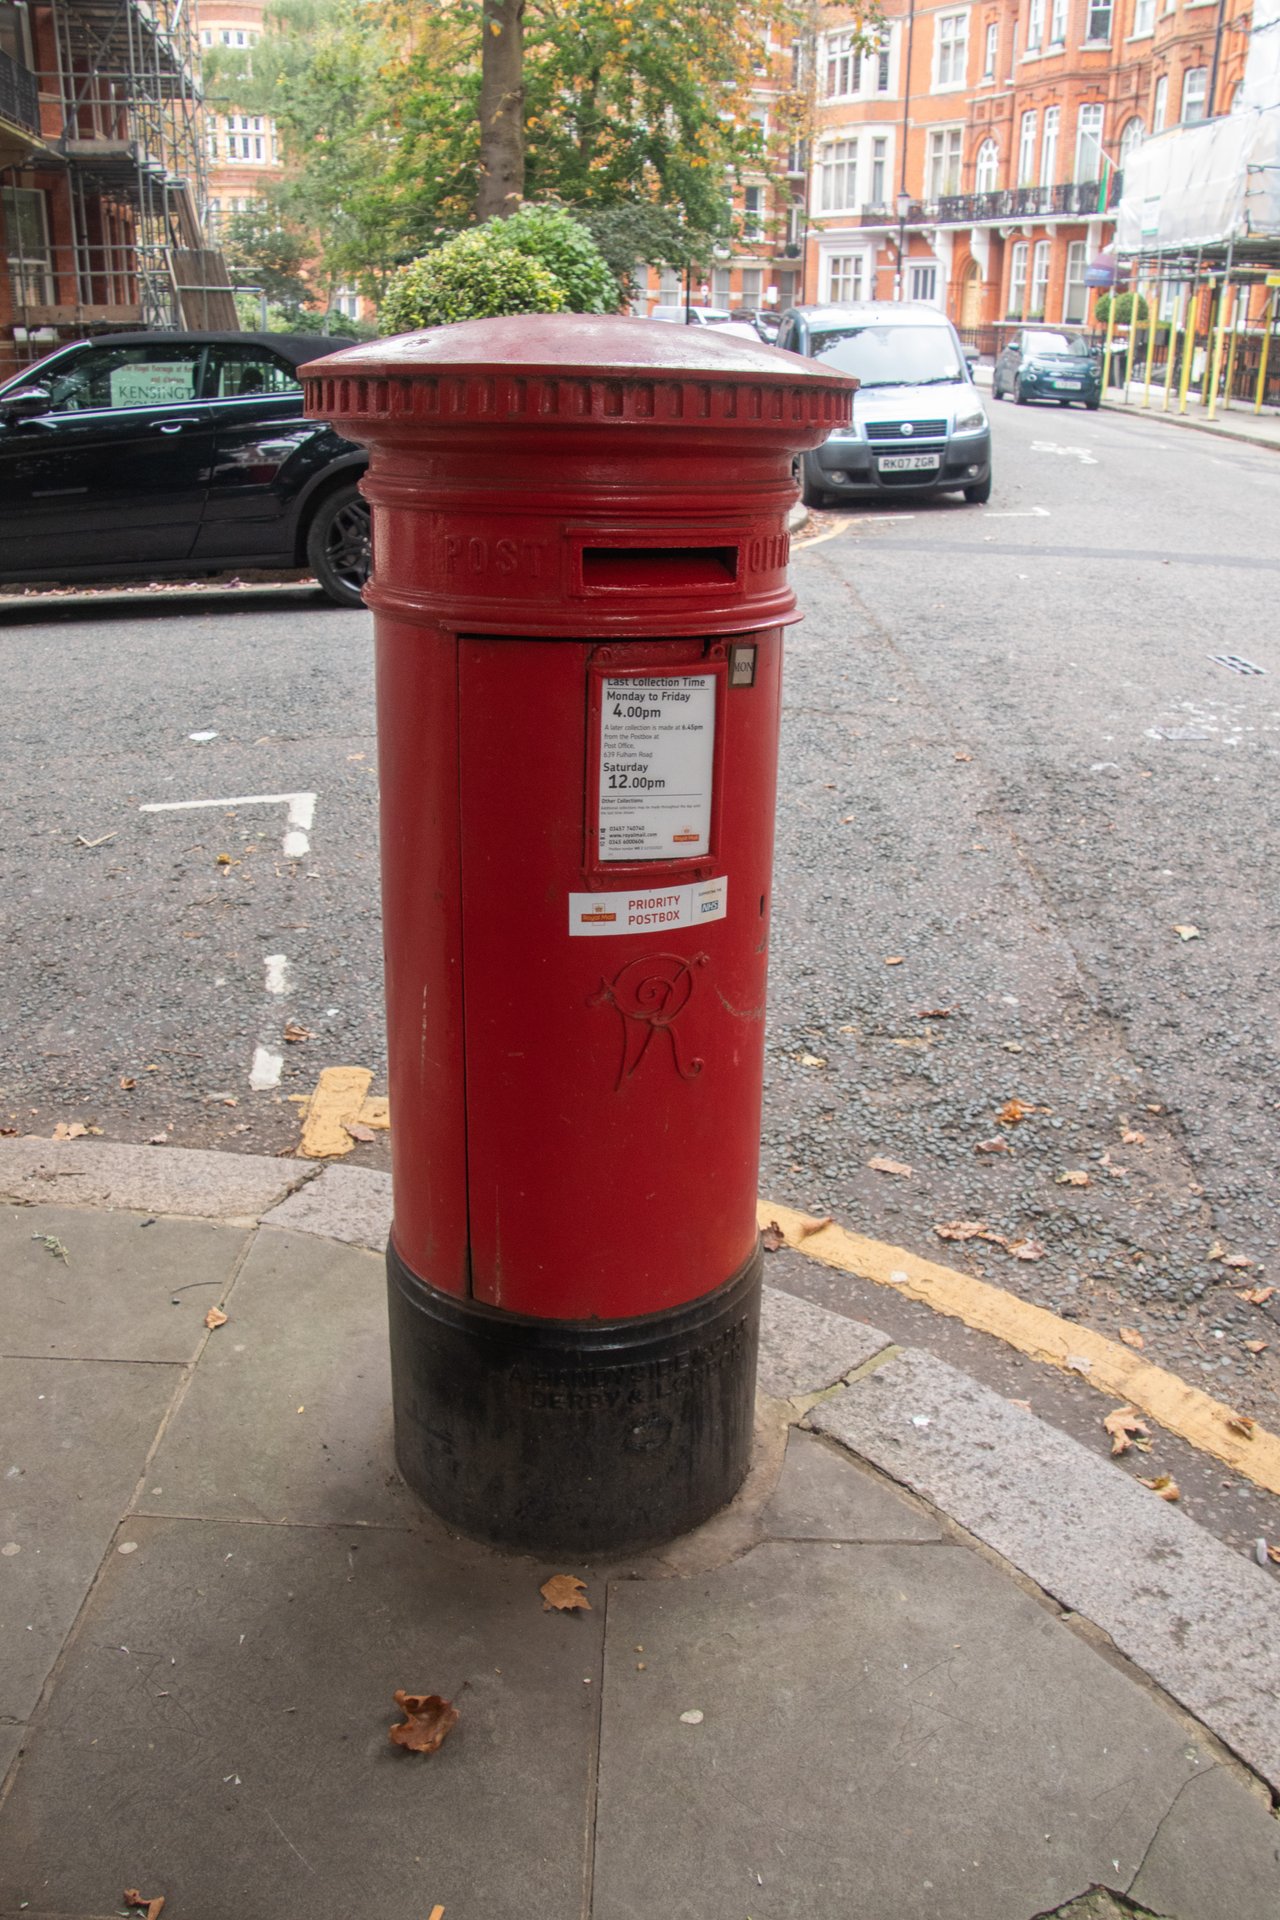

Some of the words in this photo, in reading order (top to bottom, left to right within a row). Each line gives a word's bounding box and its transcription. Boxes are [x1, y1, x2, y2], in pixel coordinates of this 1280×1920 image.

[883, 458, 911, 469] RK07
[914, 456, 935, 468] ZGR
[444, 535, 549, 578] POST
[607, 678, 629, 687] Last
[632, 677, 680, 687] Collection
[682, 677, 706, 687] Time
[607, 691, 646, 703] Monday
[649, 692, 658, 701] to
[661, 691, 691, 703] Friday
[612, 703, 661, 720] 4.00pm
[610, 723, 624, 731] later
[624, 723, 651, 731] collection
[658, 723, 674, 731] made
[681, 723, 704, 732] 6.45pm
[616, 750, 637, 758] Fulham
[638, 750, 653, 758] Road
[603, 762, 649, 774] Saturday
[608, 774, 666, 790] 12.00pm
[628, 895, 681, 911] PRIORITY
[702, 901, 718, 912] NHS
[628, 910, 680, 926] POSTBOX
